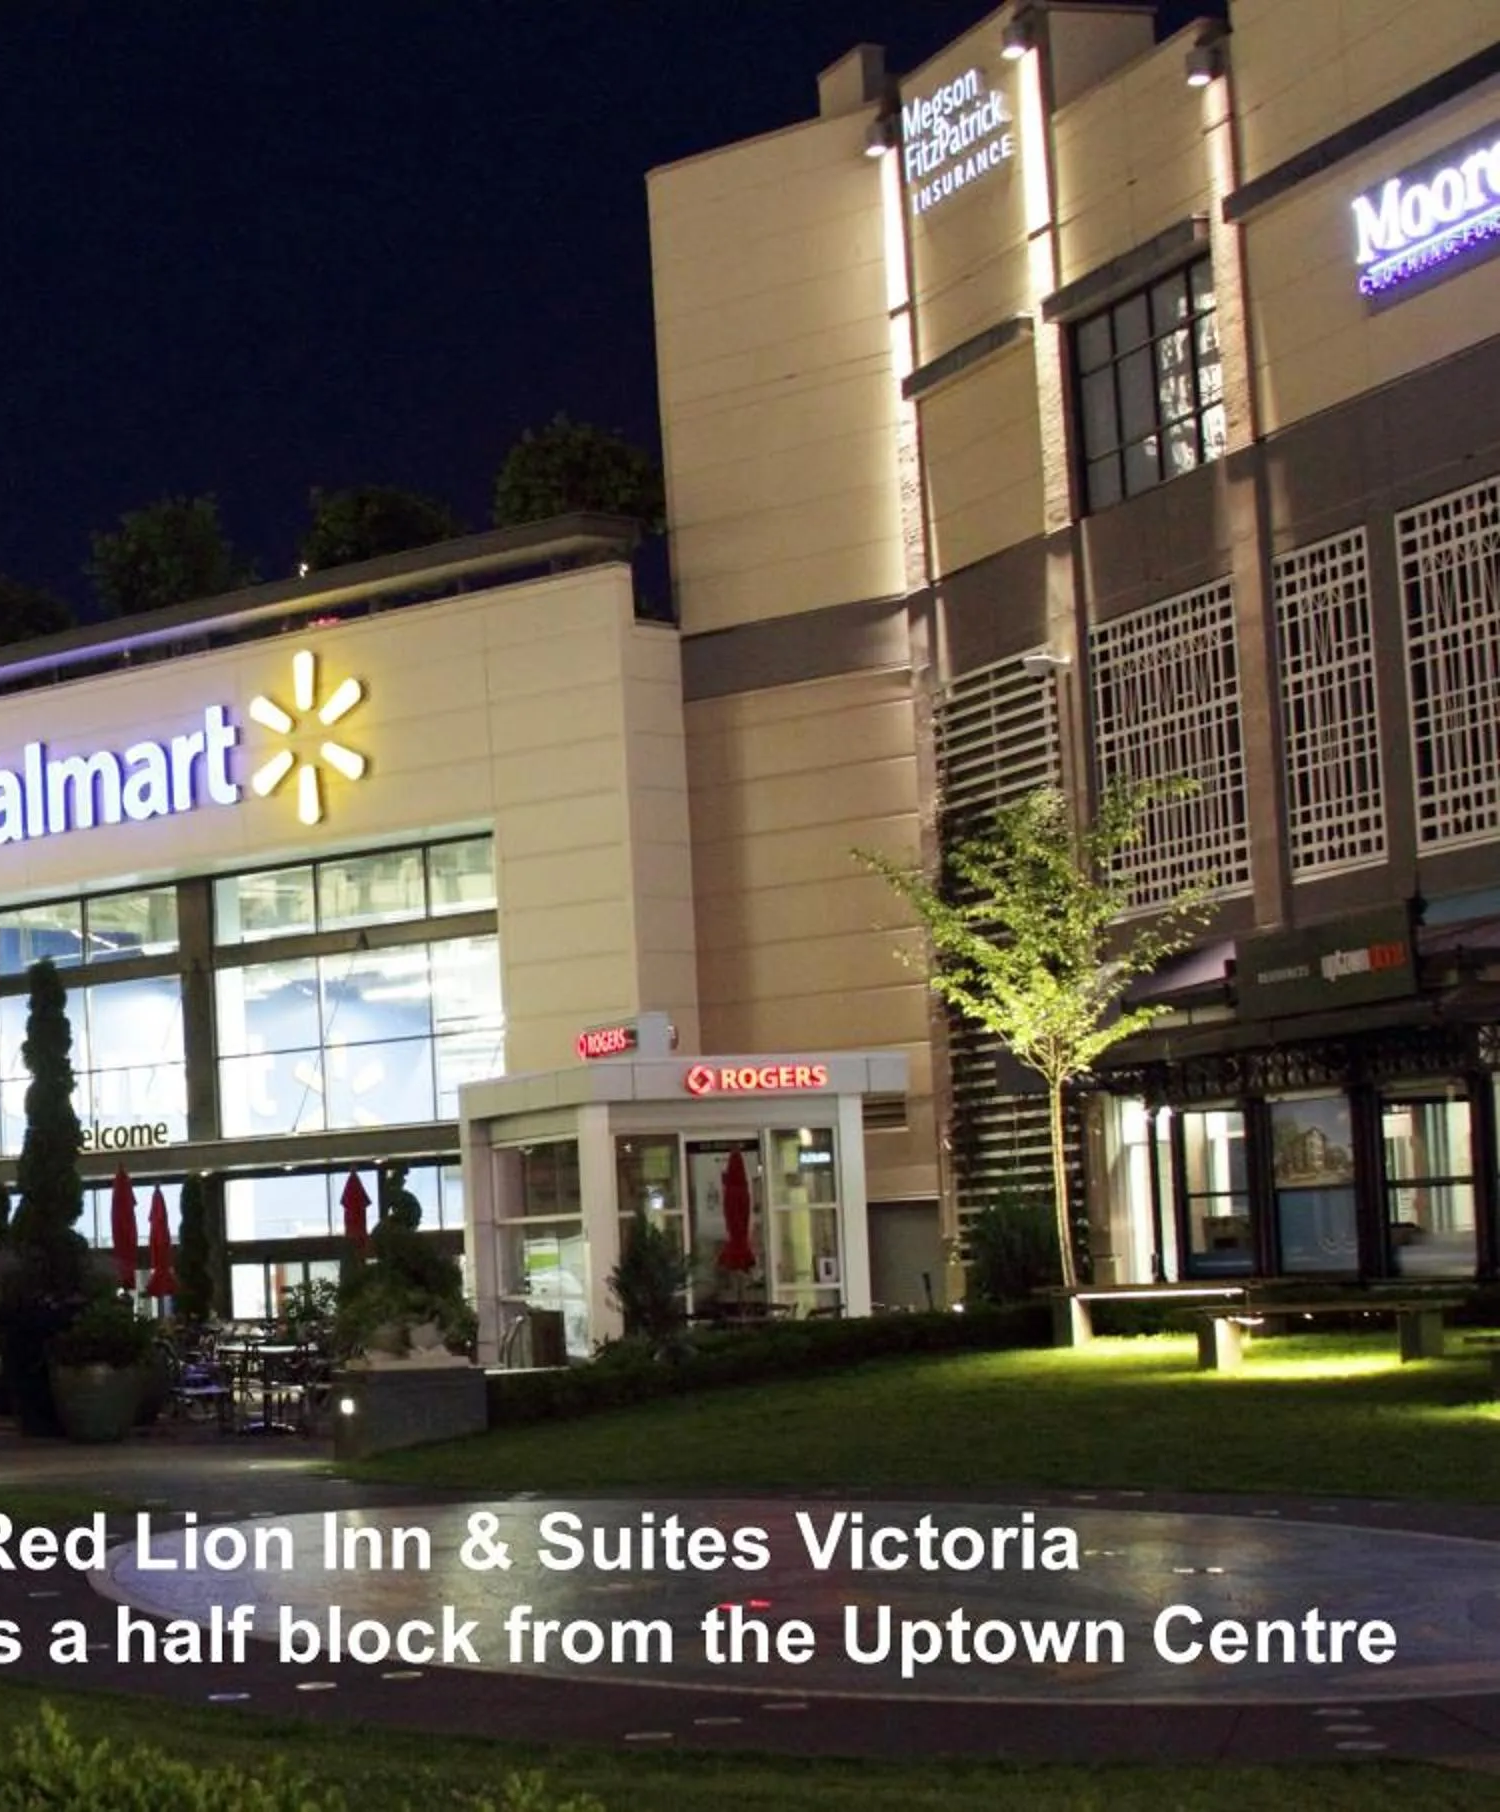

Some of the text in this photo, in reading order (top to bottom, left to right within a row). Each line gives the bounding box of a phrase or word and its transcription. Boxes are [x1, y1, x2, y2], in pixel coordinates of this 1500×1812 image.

[902, 68, 978, 142] Megson
[905, 91, 1011, 183] FitzPatrick
[912, 134, 1014, 215] INSURANCE
[587, 1027, 627, 1055] ROGERS
[720, 1064, 829, 1091] ROGERS
[80, 1119, 168, 1151] elcome
